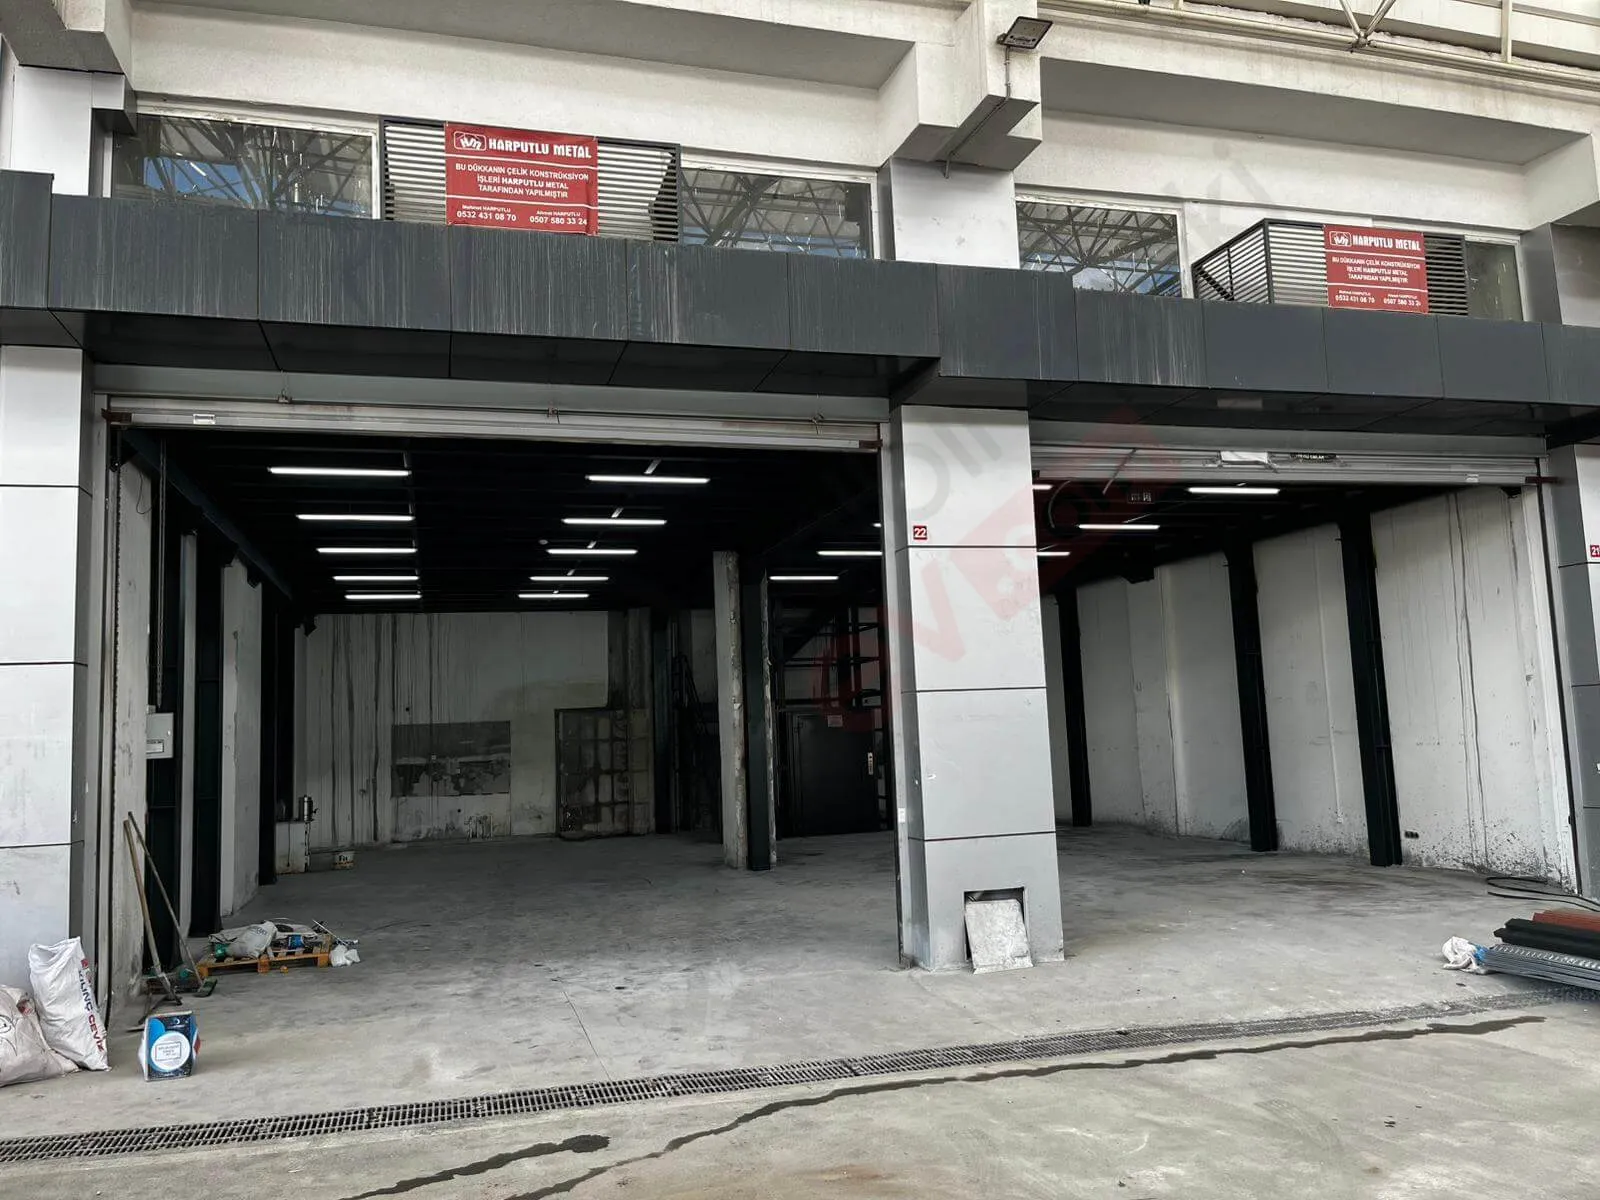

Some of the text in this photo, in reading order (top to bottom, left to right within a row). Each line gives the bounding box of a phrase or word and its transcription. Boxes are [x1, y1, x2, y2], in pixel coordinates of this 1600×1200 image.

[489, 138, 592, 158] HARPUTLU METAL
[456, 163, 466, 171] BU
[467, 163, 505, 174] DÜKKANIN
[507, 167, 528, 176] ÇELİK
[477, 173, 569, 189] İŞLERİ HARPUTLU METAL
[479, 184, 568, 198] TARAFINDAN YAPILMIŞTIR
[456, 210, 477, 218] 0532
[478, 211, 493, 219] 431
[506, 213, 517, 222] 70
[529, 216, 588, 226] 0507 580 33 24
[1352, 235, 1421, 251] HARPUTLU METAL
[914, 527, 927, 538] 22
